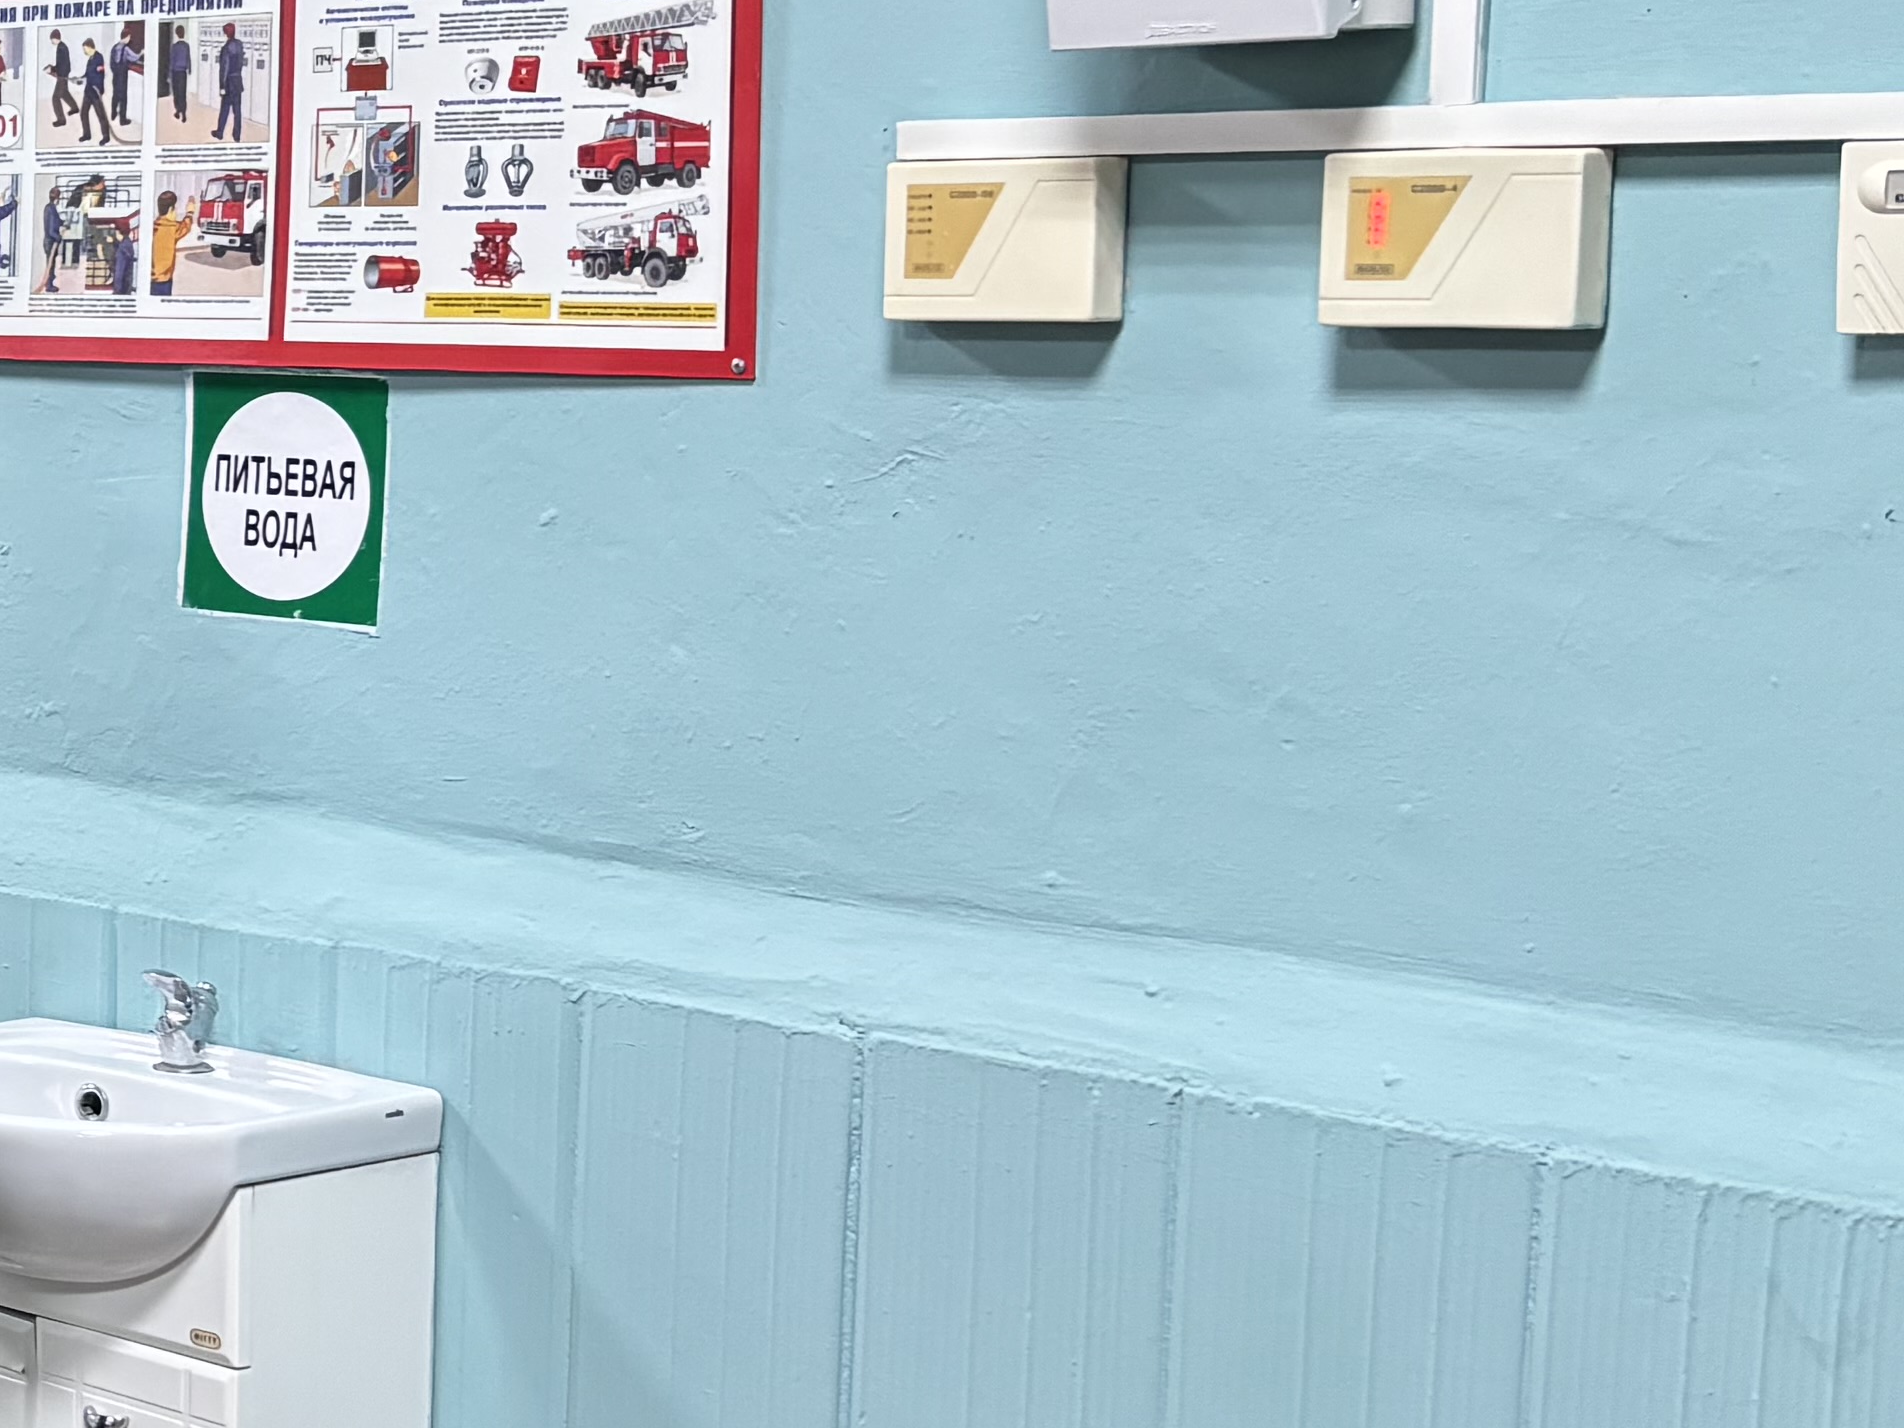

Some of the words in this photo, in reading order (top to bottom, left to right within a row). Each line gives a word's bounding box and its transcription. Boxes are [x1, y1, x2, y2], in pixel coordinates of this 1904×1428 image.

[23, 4, 48, 22] ПРИ
[55, 0, 111, 20] ПОЖАРЕ
[117, 0, 134, 16] НА
[315, 53, 333, 67] ПЧ
[215, 454, 355, 500] ПИТЬЕВАЯ
[244, 509, 316, 558] ВОДА
